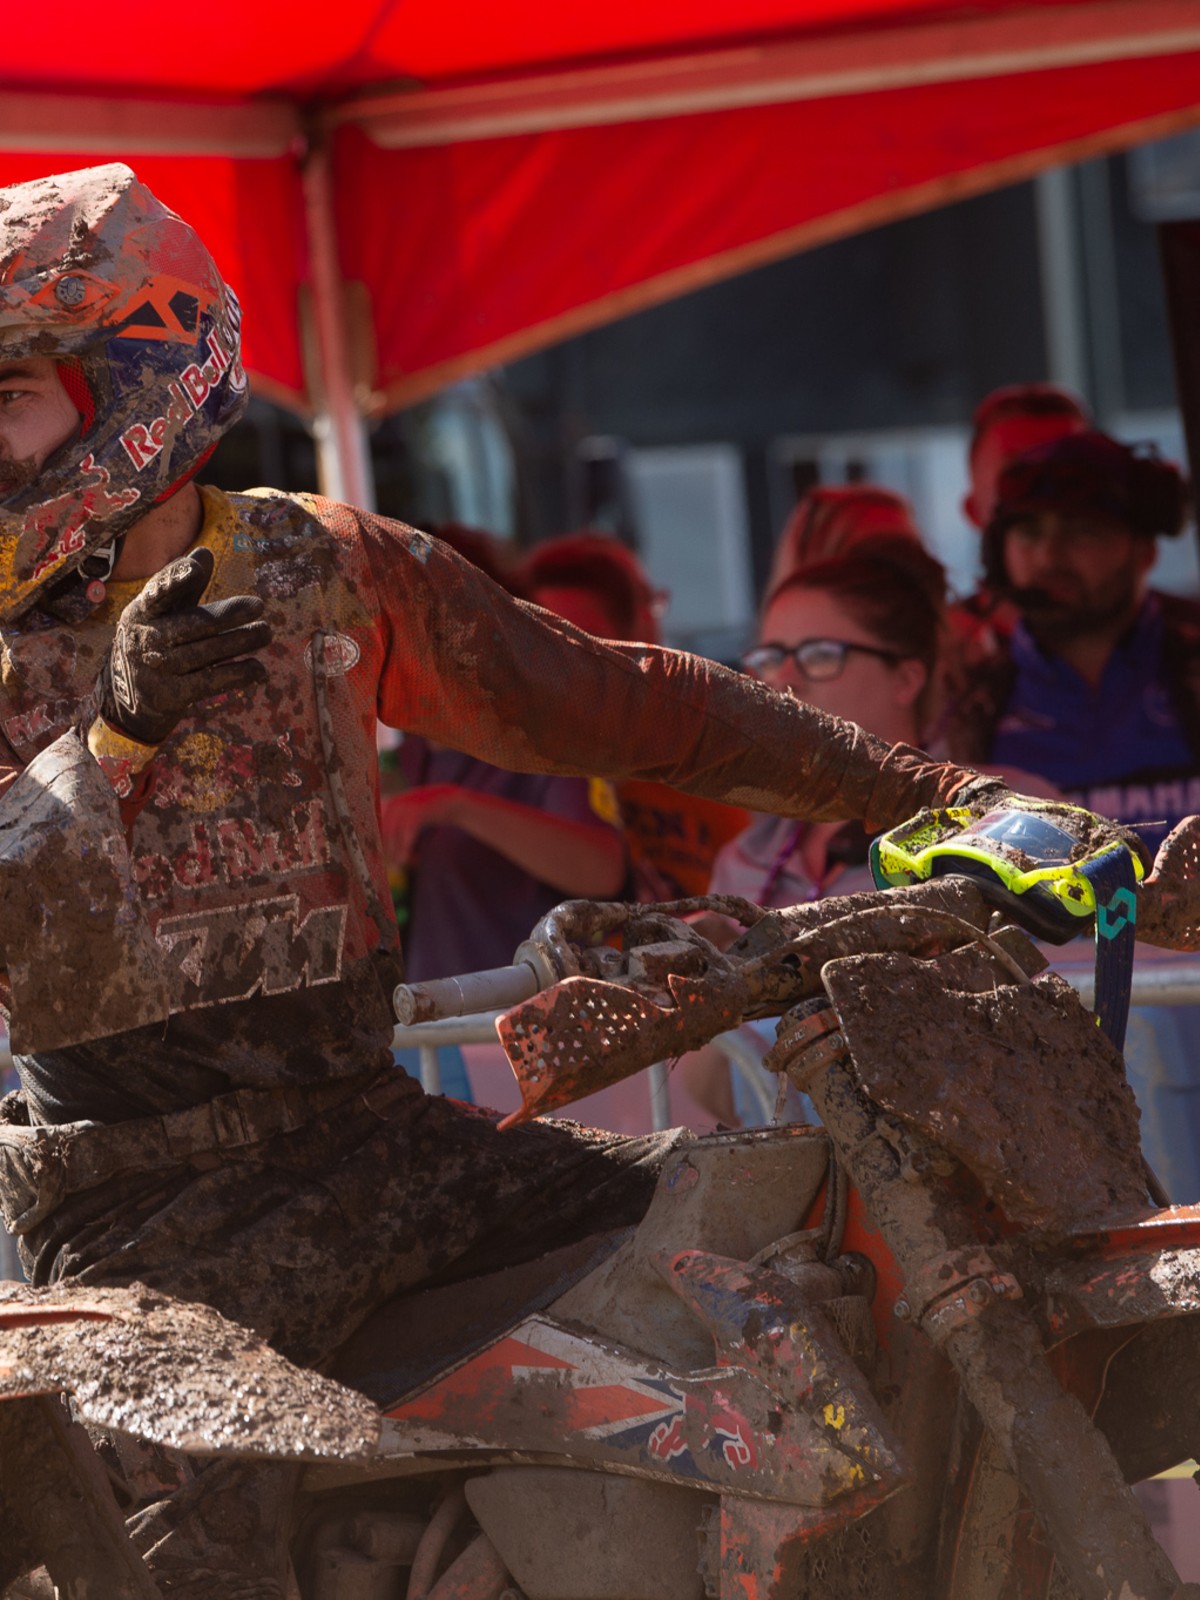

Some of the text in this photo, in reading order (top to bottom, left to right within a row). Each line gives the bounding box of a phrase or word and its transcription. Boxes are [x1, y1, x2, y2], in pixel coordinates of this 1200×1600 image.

[118, 326, 232, 472] Red Bull
[132, 820, 216, 899] ed
